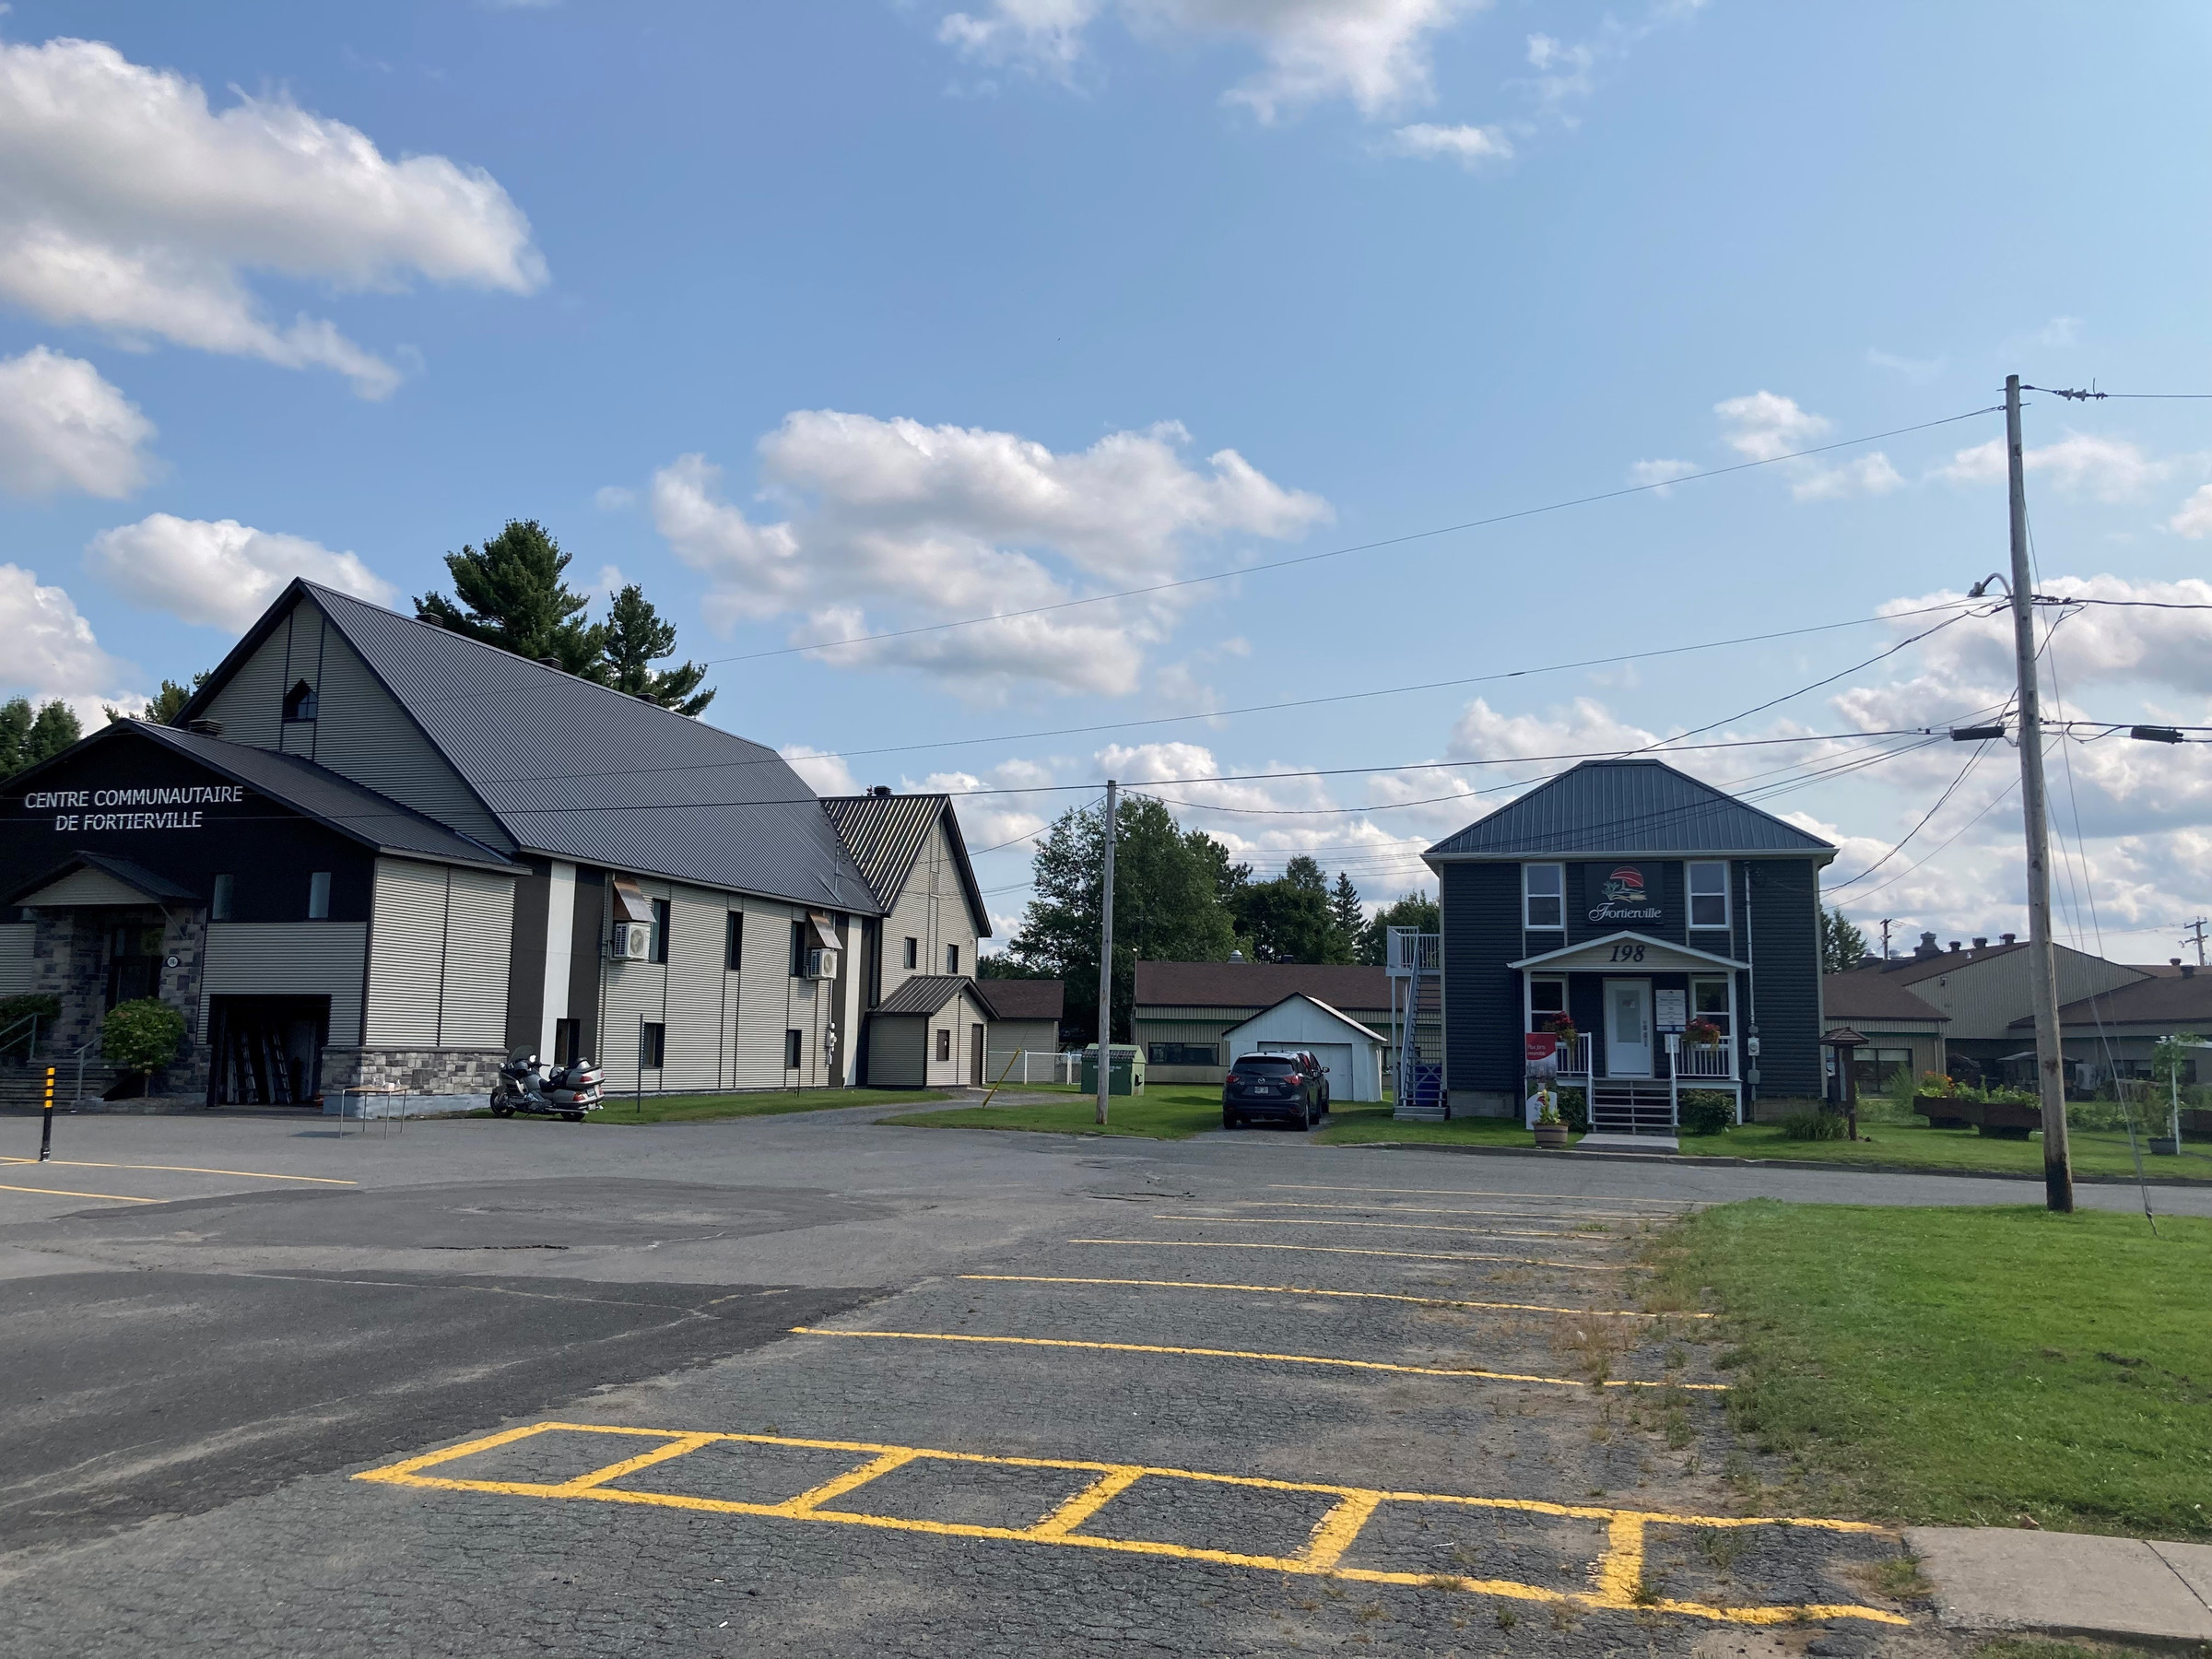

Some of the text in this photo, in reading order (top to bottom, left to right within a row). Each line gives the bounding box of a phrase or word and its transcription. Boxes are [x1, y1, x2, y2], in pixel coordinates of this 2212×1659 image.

[24, 785, 243, 808] CENTRE COMMUNAUTAIRE
[55, 811, 203, 830] DE FORTIERVILLE
[1588, 902, 1662, 922] Fortierville
[1609, 944, 1645, 962] 198
